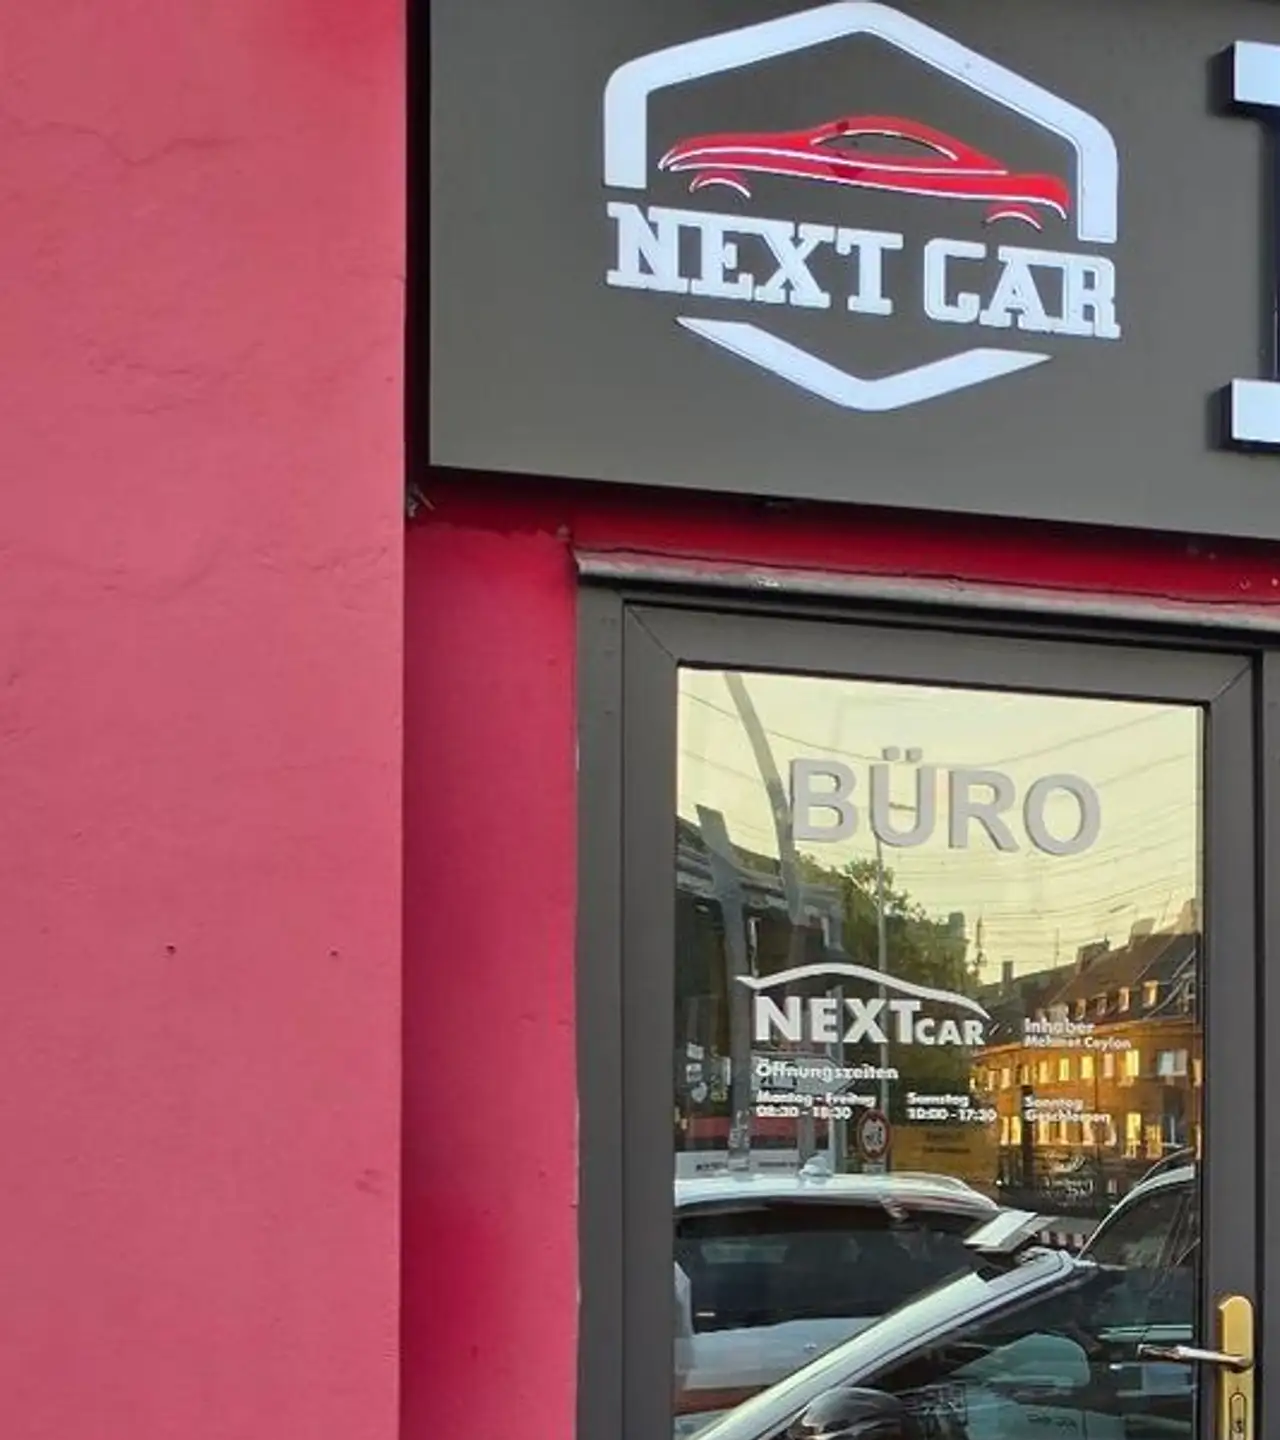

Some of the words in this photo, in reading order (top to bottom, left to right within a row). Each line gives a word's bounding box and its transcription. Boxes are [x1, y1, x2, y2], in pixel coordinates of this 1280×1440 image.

[606, 201, 904, 316] NEXT
[923, 237, 1121, 340] CAR
[790, 747, 1101, 857] BÜRO
[755, 1056, 899, 1082] Öffnungszeiten
